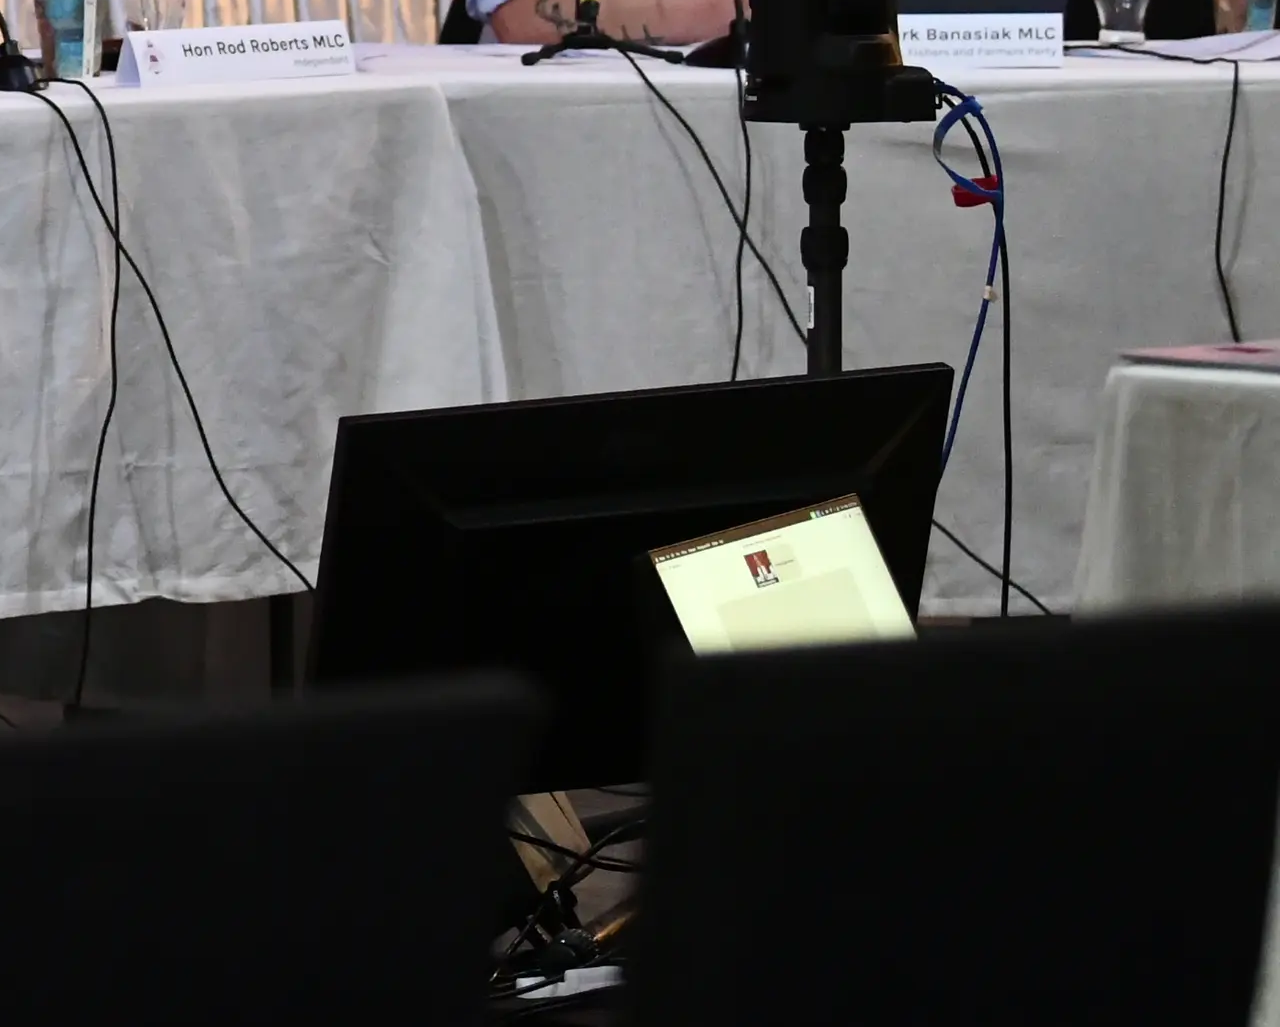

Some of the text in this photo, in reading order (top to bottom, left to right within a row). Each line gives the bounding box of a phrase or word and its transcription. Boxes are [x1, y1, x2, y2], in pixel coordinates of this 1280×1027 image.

[902, 27, 1056, 41] rk Banasiak MLC
[182, 34, 345, 57] Hon Rod Roberts MLC
